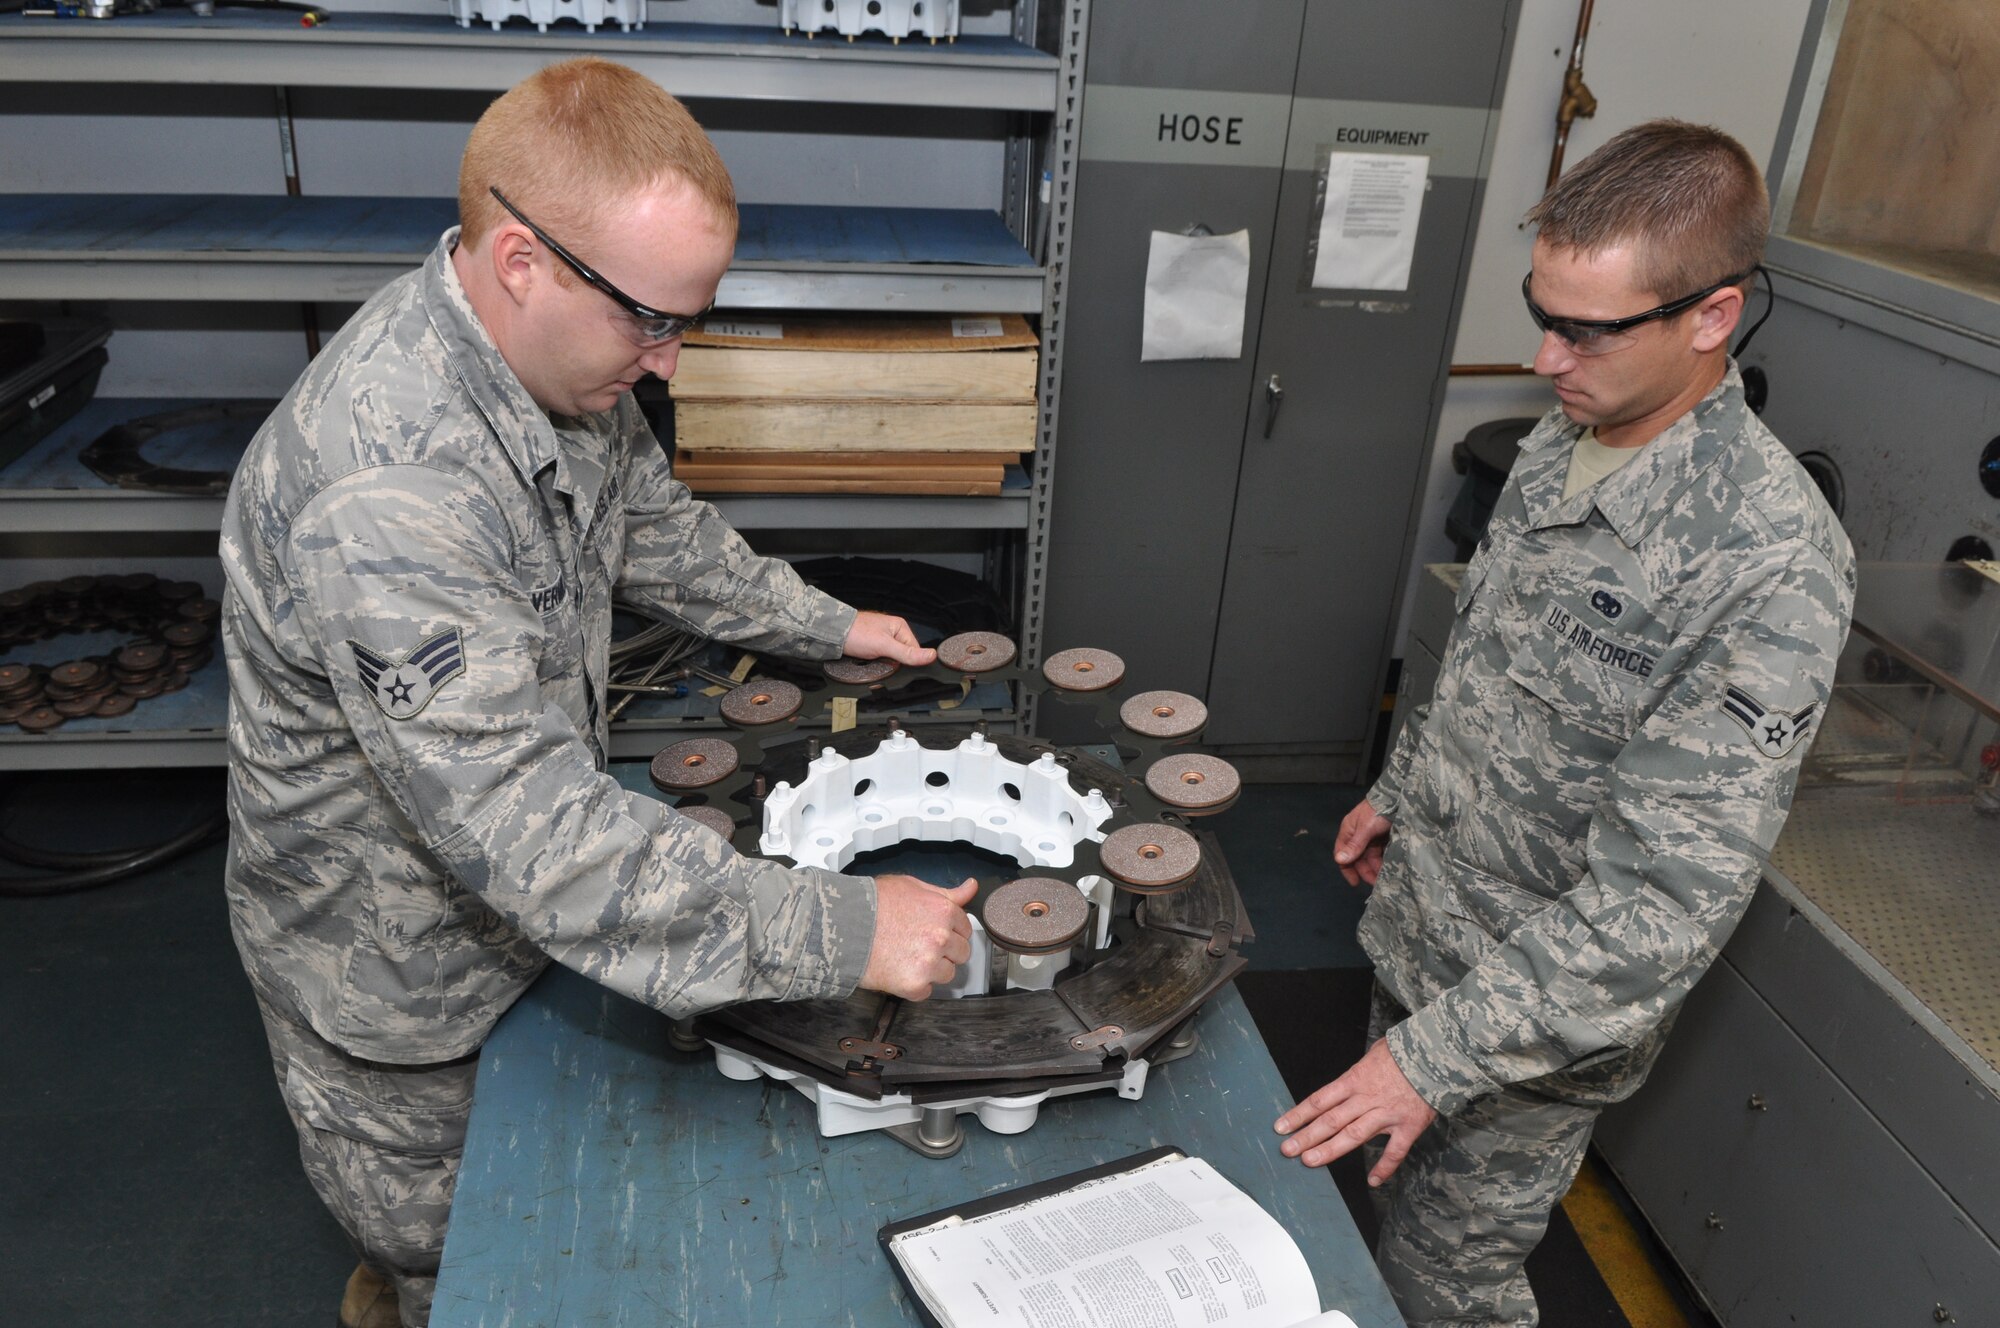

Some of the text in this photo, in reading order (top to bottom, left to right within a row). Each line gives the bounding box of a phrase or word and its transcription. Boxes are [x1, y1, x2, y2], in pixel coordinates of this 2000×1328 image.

[1158, 114, 1244, 145] HOSE
[1336, 127, 1430, 146] EQUIPMENT
[1547, 606, 1656, 678] U.S. AIR FORCE
[986, 1299, 999, 1315] SAFETY
